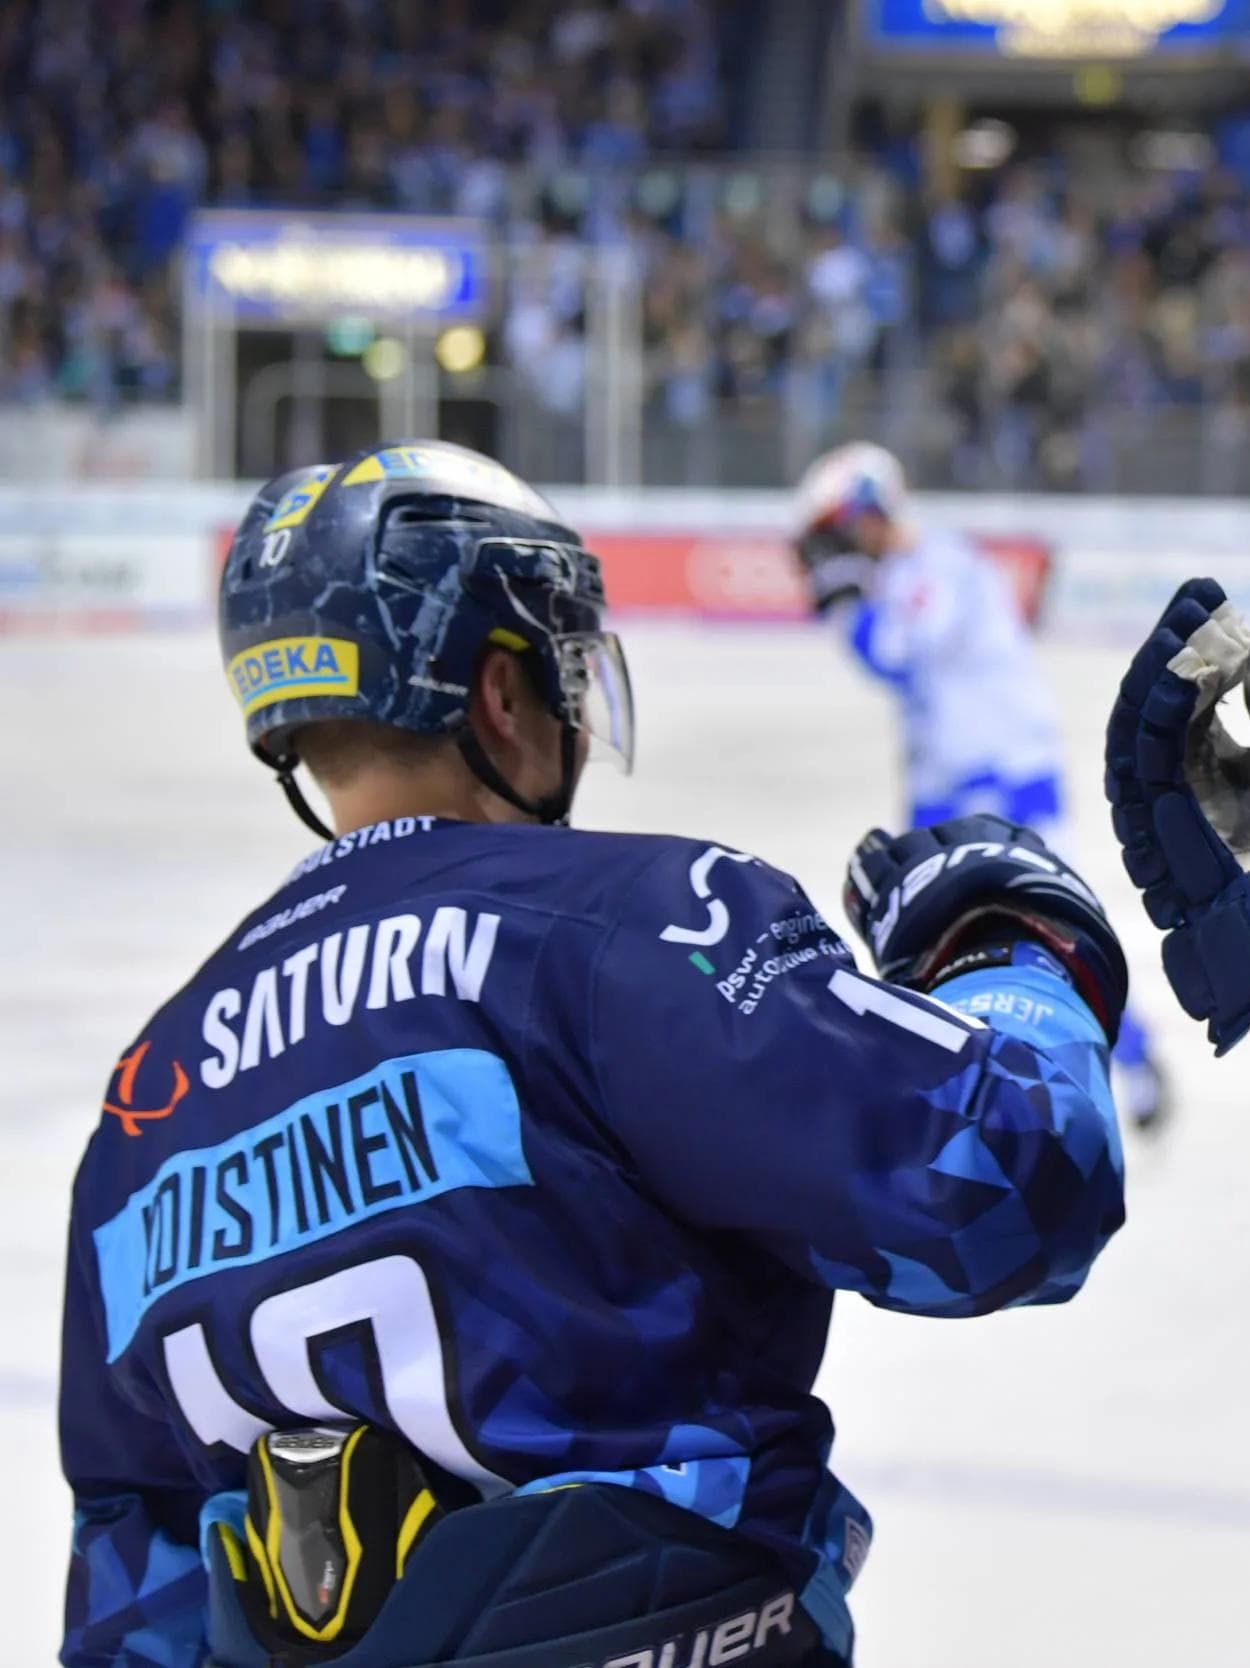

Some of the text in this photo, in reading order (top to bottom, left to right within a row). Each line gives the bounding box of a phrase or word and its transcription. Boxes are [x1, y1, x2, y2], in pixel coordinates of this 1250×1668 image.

[258, 528, 292, 568] 10
[232, 643, 340, 695] EDEKA
[200, 906, 501, 1090] SATURN
[715, 948, 758, 1003] psw
